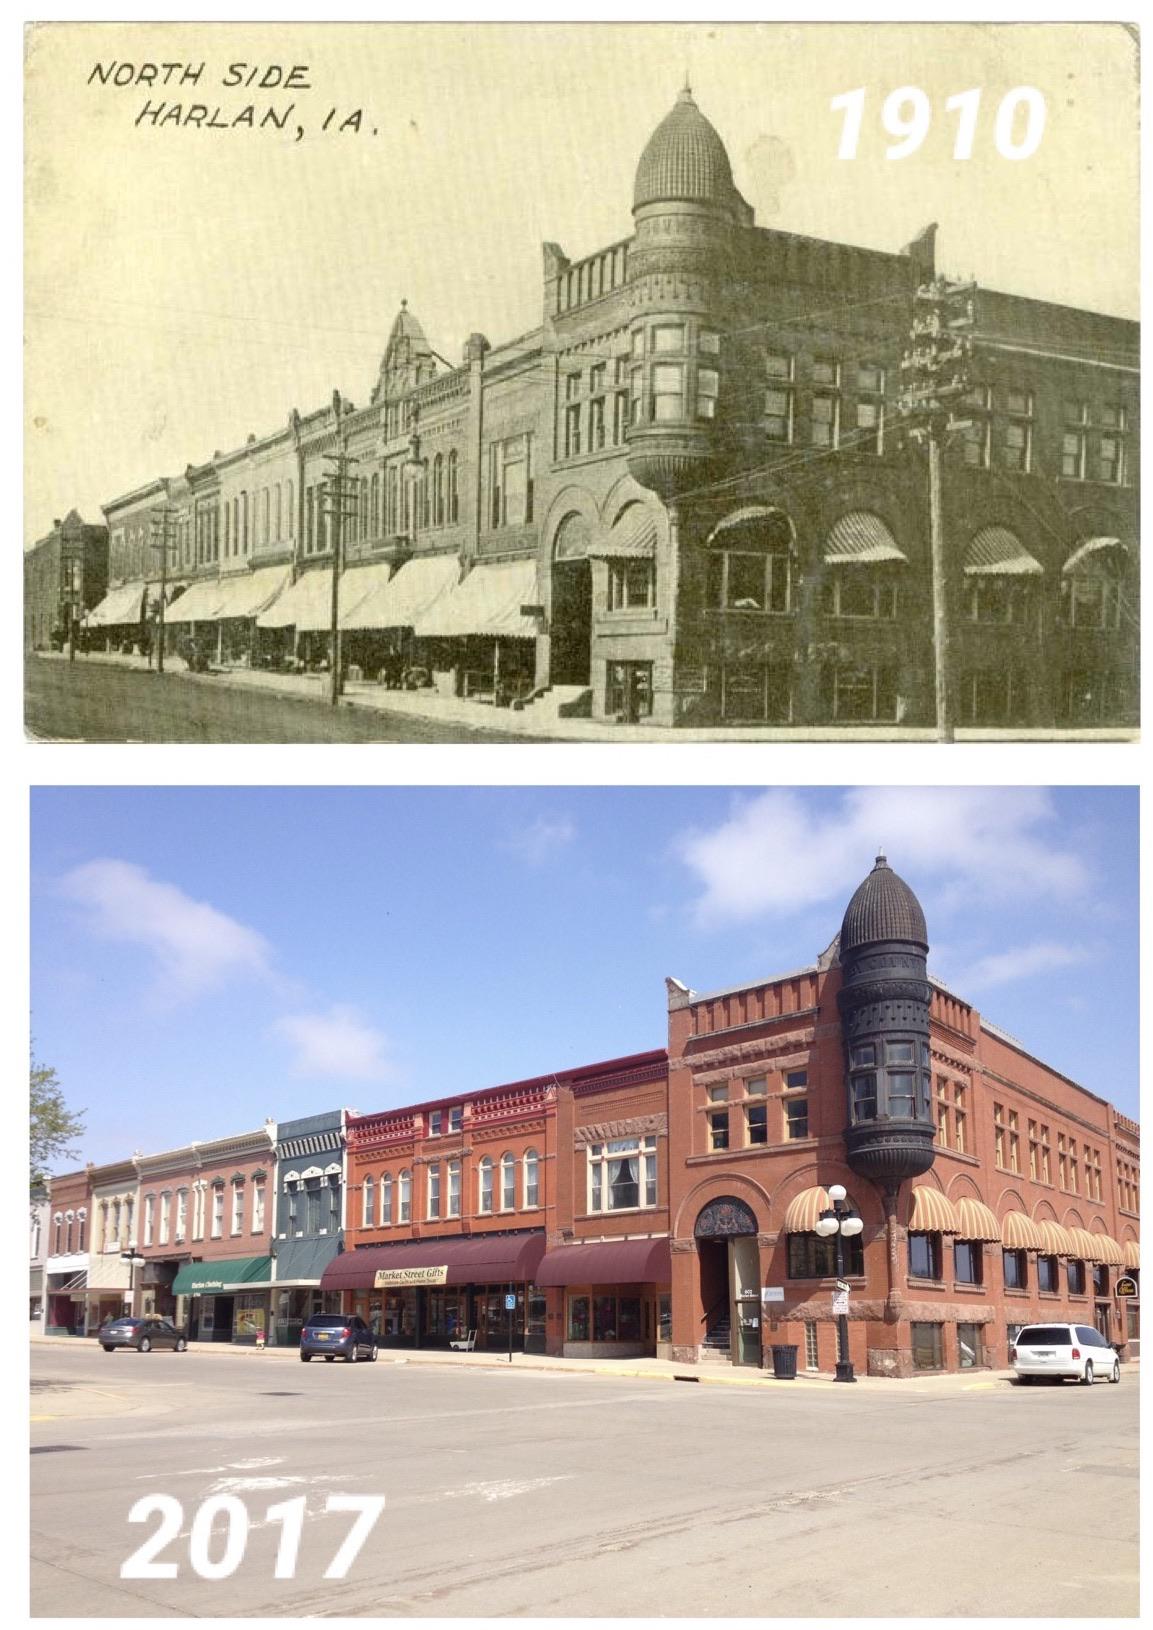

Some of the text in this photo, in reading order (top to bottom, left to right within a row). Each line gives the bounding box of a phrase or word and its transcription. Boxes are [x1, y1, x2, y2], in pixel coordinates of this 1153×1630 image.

[377, 1267, 444, 1280] Market Street Gifts
